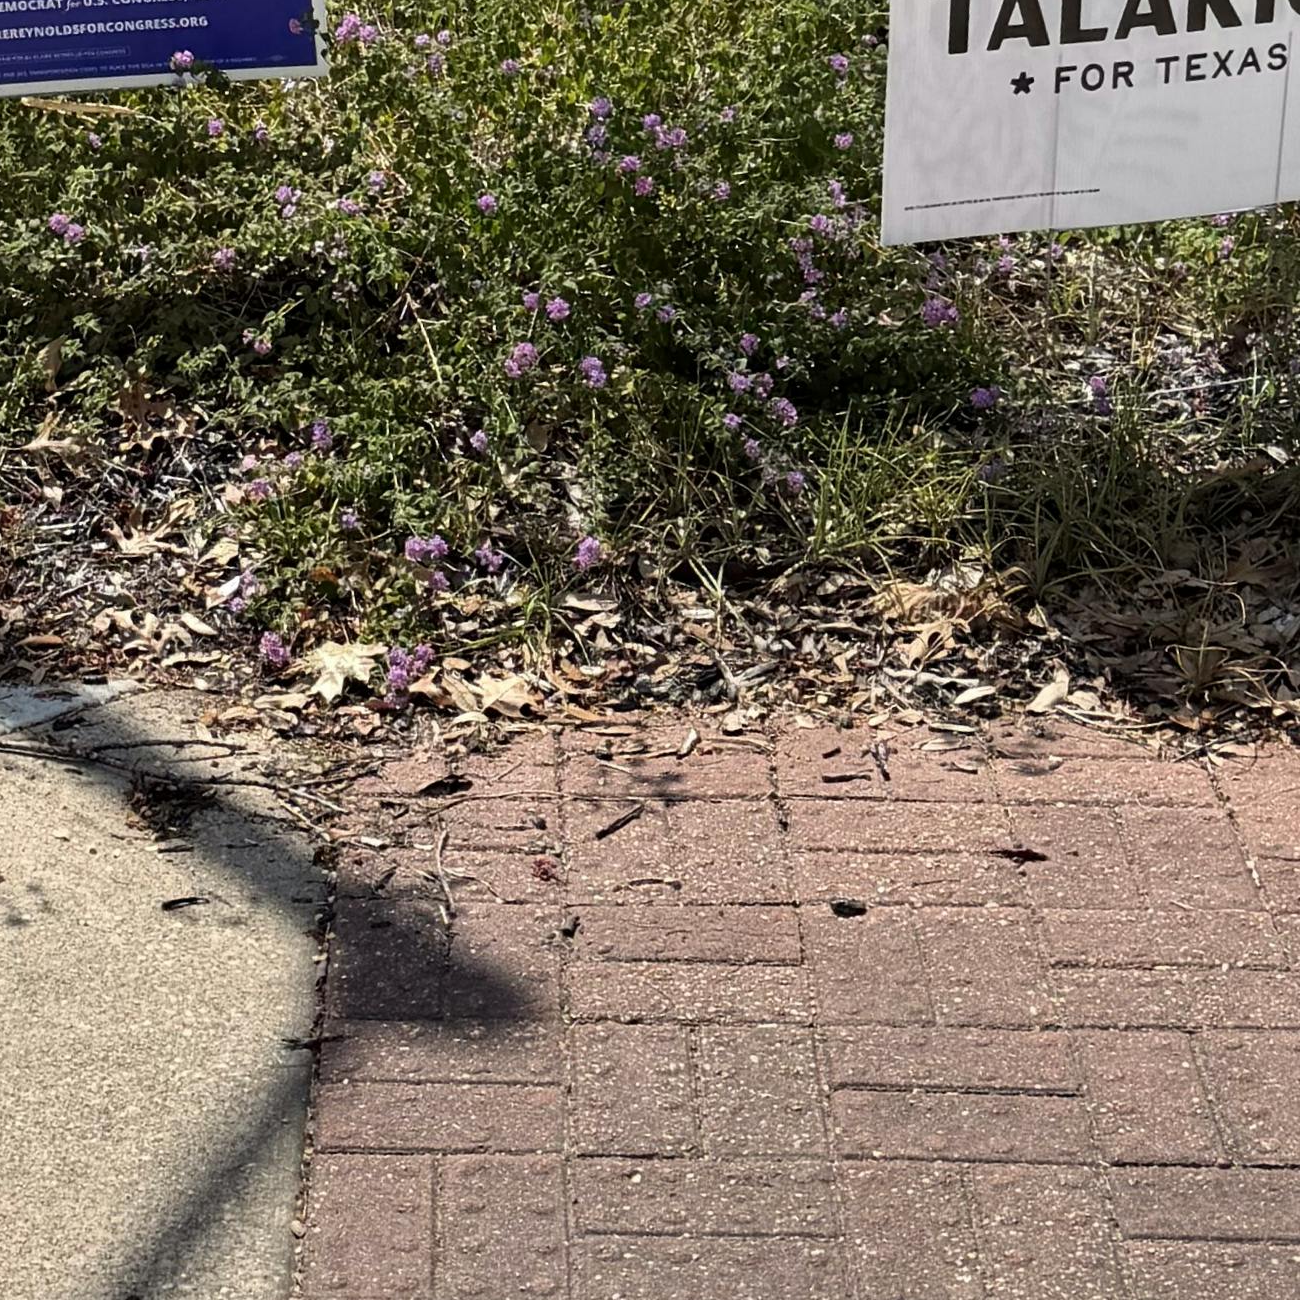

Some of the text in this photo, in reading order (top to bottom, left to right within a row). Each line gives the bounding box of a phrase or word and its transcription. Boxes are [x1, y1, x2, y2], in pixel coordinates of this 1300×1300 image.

[65, 0, 82, 12] for
[1054, 43, 1288, 94] FOR TEXAS
